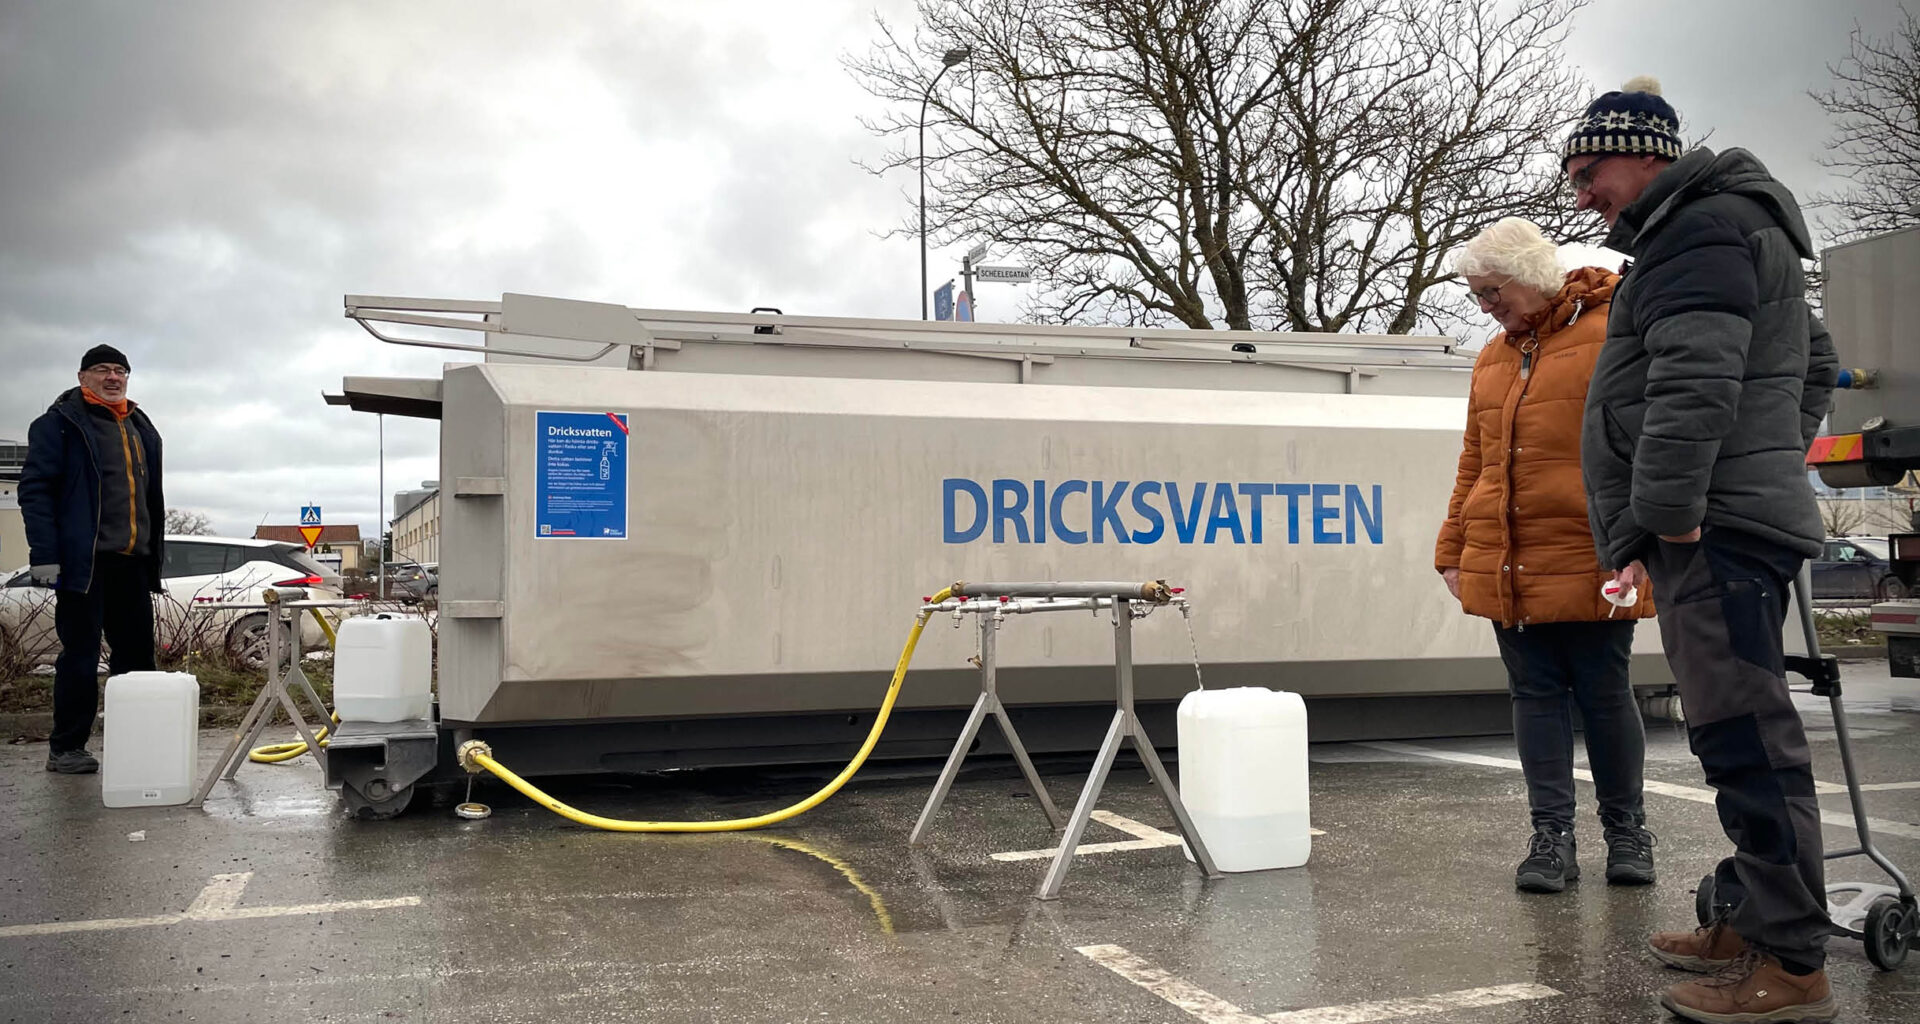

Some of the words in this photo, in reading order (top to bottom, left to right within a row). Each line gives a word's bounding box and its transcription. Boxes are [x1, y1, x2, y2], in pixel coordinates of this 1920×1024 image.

[981, 270, 1029, 278] SCHEELEGATAN
[548, 426, 612, 437] Dricksvatten
[943, 478, 1383, 545] DRICKSVATTEN
